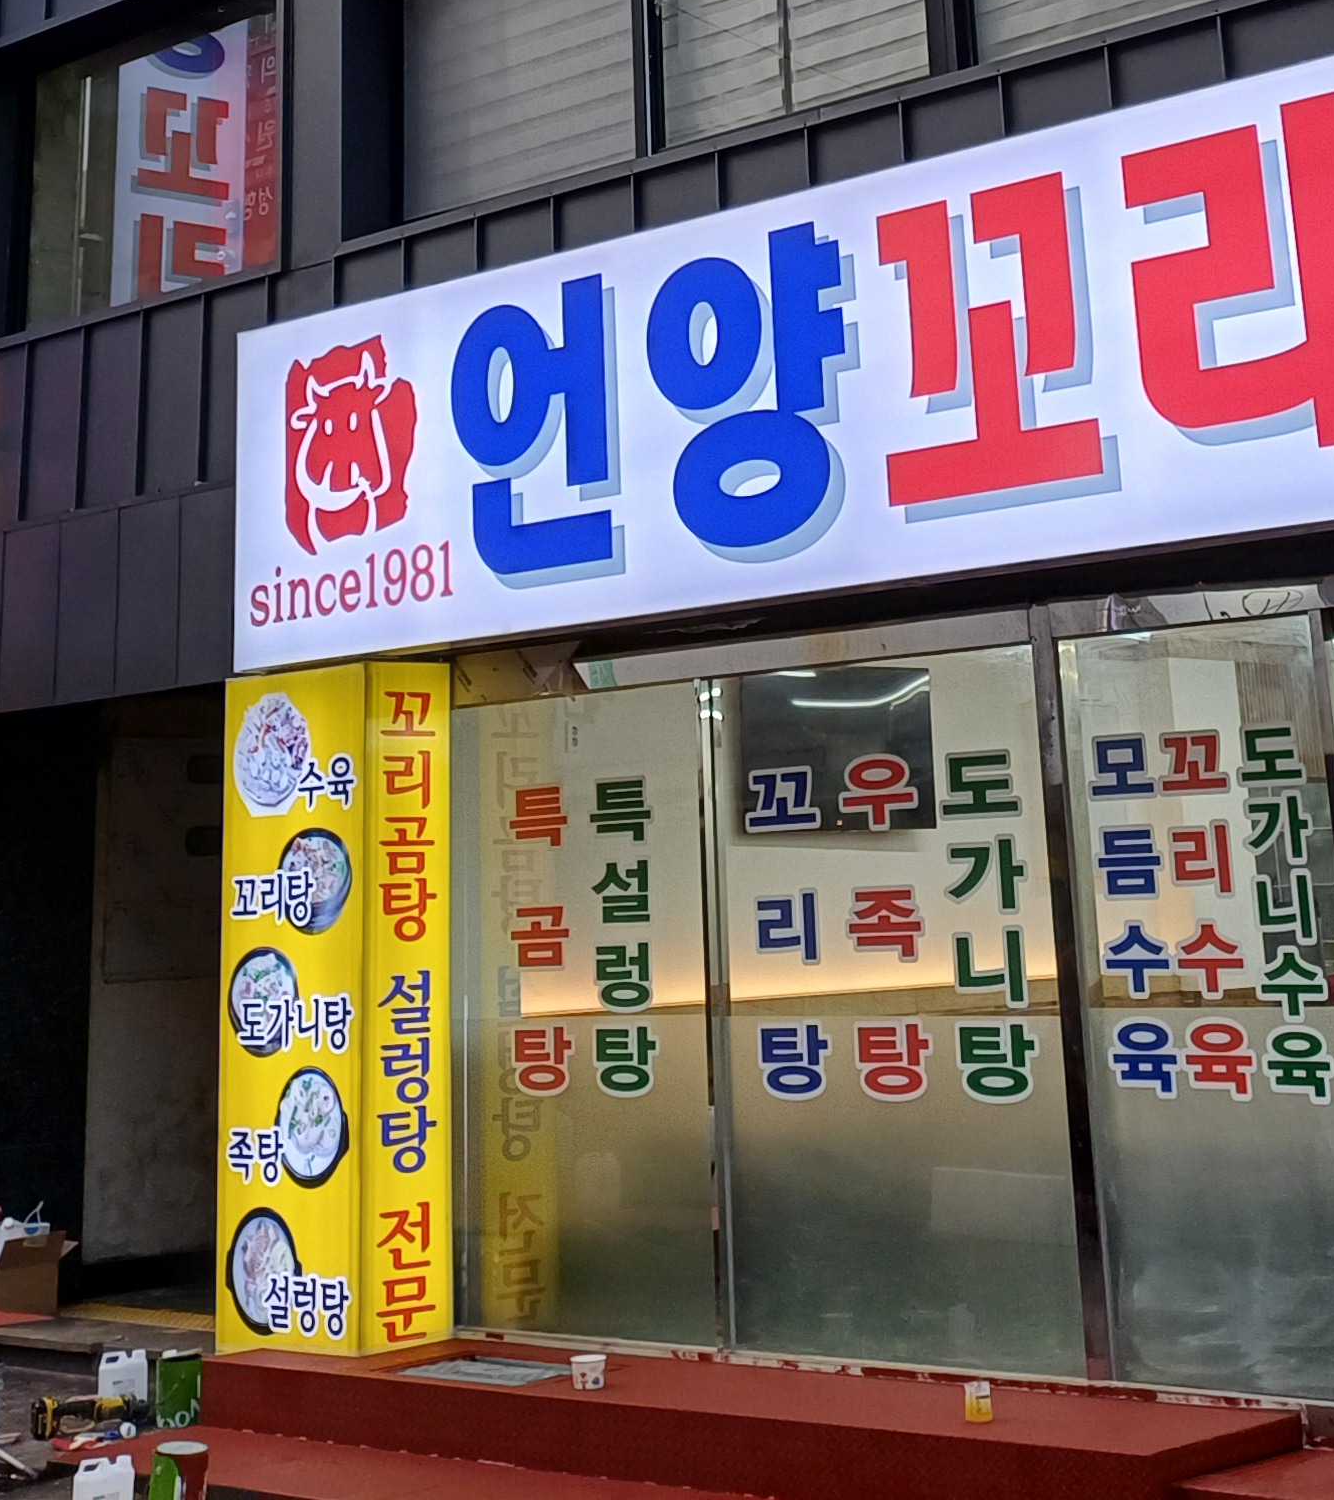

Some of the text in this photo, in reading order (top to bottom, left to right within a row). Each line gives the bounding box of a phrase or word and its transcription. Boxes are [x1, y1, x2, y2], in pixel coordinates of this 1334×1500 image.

[250, 541, 454, 627] since1981
[298, 757, 354, 807] 수육
[233, 871, 314, 924] 꼬리탕
[239, 998, 351, 1050] 도가니탕
[377, 691, 438, 1343] 꼬리곰탕 설렁탕 전문
[228, 1131, 284, 1183] 족탕
[264, 1276, 349, 1335] 설렁탕
